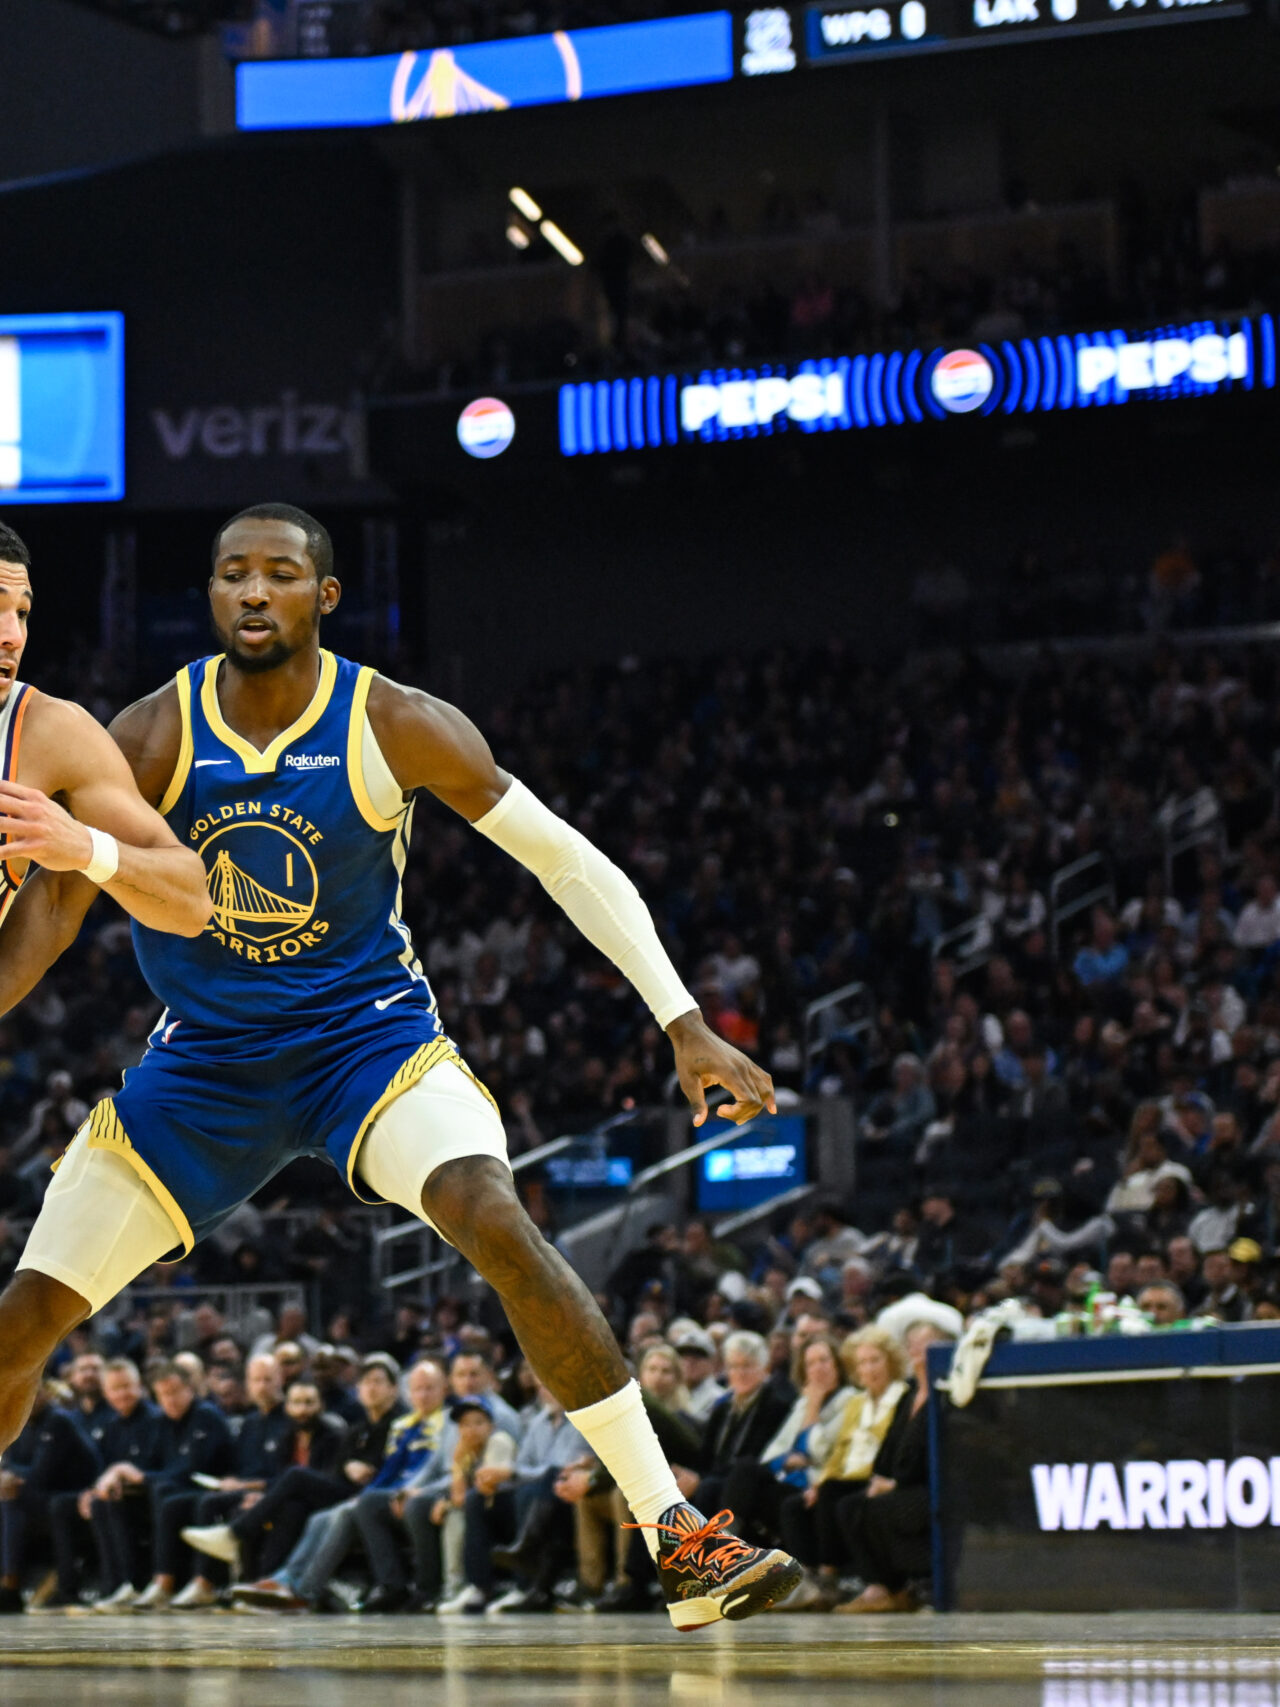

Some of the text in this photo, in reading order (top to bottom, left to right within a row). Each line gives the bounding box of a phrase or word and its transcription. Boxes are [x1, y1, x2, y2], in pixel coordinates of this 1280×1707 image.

[821, 8, 891, 46] WPG
[1077, 331, 1247, 394] PEPSI
[681, 371, 842, 431] PEPSI
[285, 753, 340, 770] Rakuten
[189, 801, 324, 846] GOLDEN STATE
[285, 852, 293, 887] 1
